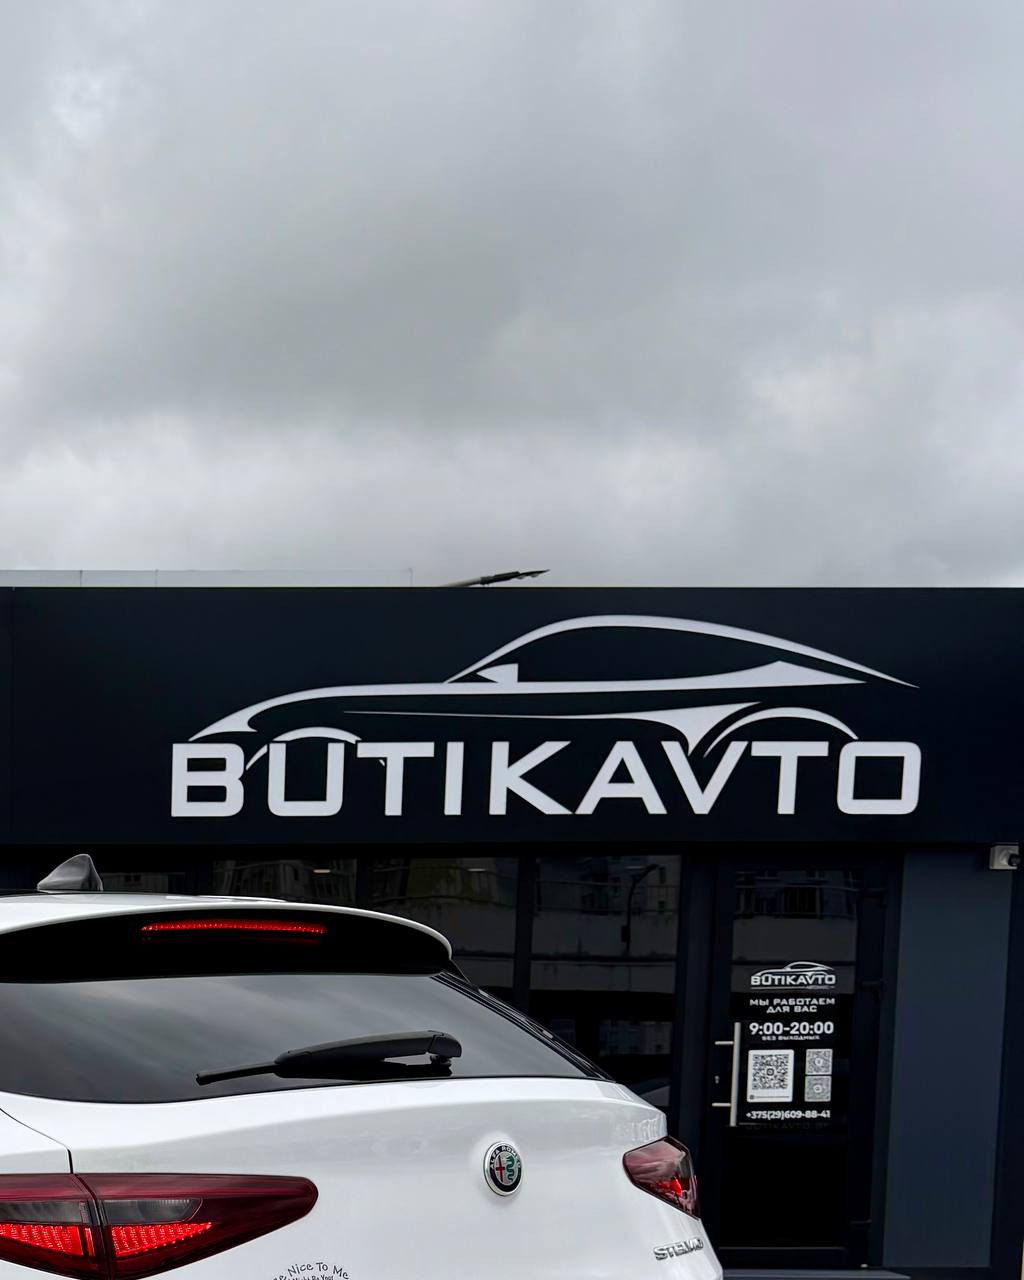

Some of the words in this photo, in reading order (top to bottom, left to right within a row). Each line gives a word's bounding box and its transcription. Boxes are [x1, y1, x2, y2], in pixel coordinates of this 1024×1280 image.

[171, 741, 921, 818] BUTIKAVTO
[750, 975, 836, 986] BUTIKAVTO
[773, 998, 836, 1006] РАБОТАЕМ
[794, 1005, 817, 1013] ВАС
[749, 1021, 835, 1036] 9:00-20:00
[746, 1110, 831, 1121] +375(29)609-88-41
[287, 1263, 314, 1277] Nice
[316, 1262, 329, 1272] To
